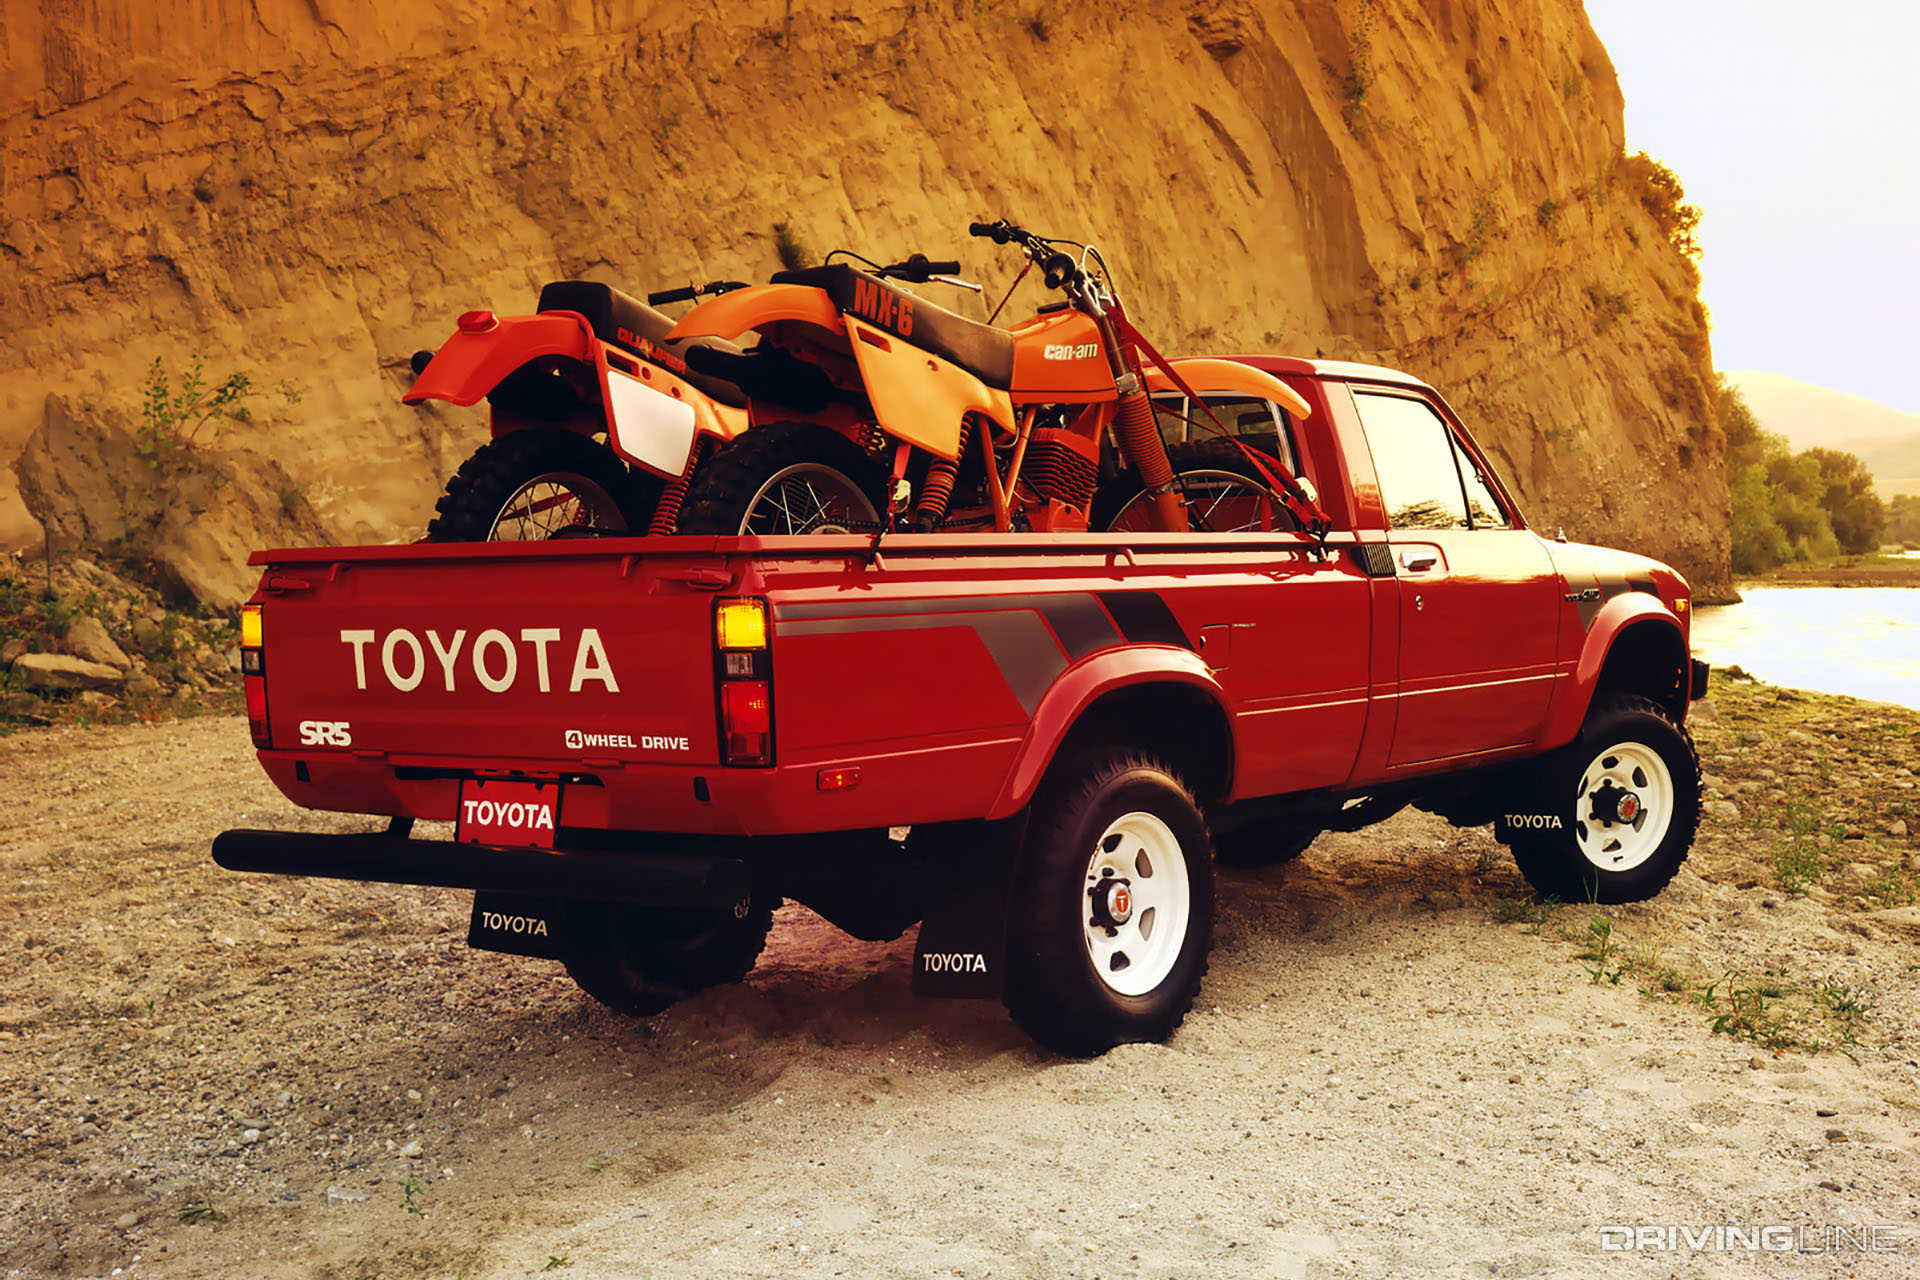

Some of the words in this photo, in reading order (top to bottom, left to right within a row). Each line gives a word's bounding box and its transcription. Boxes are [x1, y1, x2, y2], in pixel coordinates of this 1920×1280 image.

[854, 276, 914, 337] MX-6
[1044, 343, 1098, 361] can-am
[340, 628, 620, 693] TOYOTA
[299, 720, 352, 747] SR5
[641, 735, 690, 751] DRIVE
[463, 800, 553, 830] TOYOTA
[1504, 814, 1563, 829] TOYOTA
[482, 911, 548, 937] TOYOTA
[923, 953, 987, 973] TOYOTA
